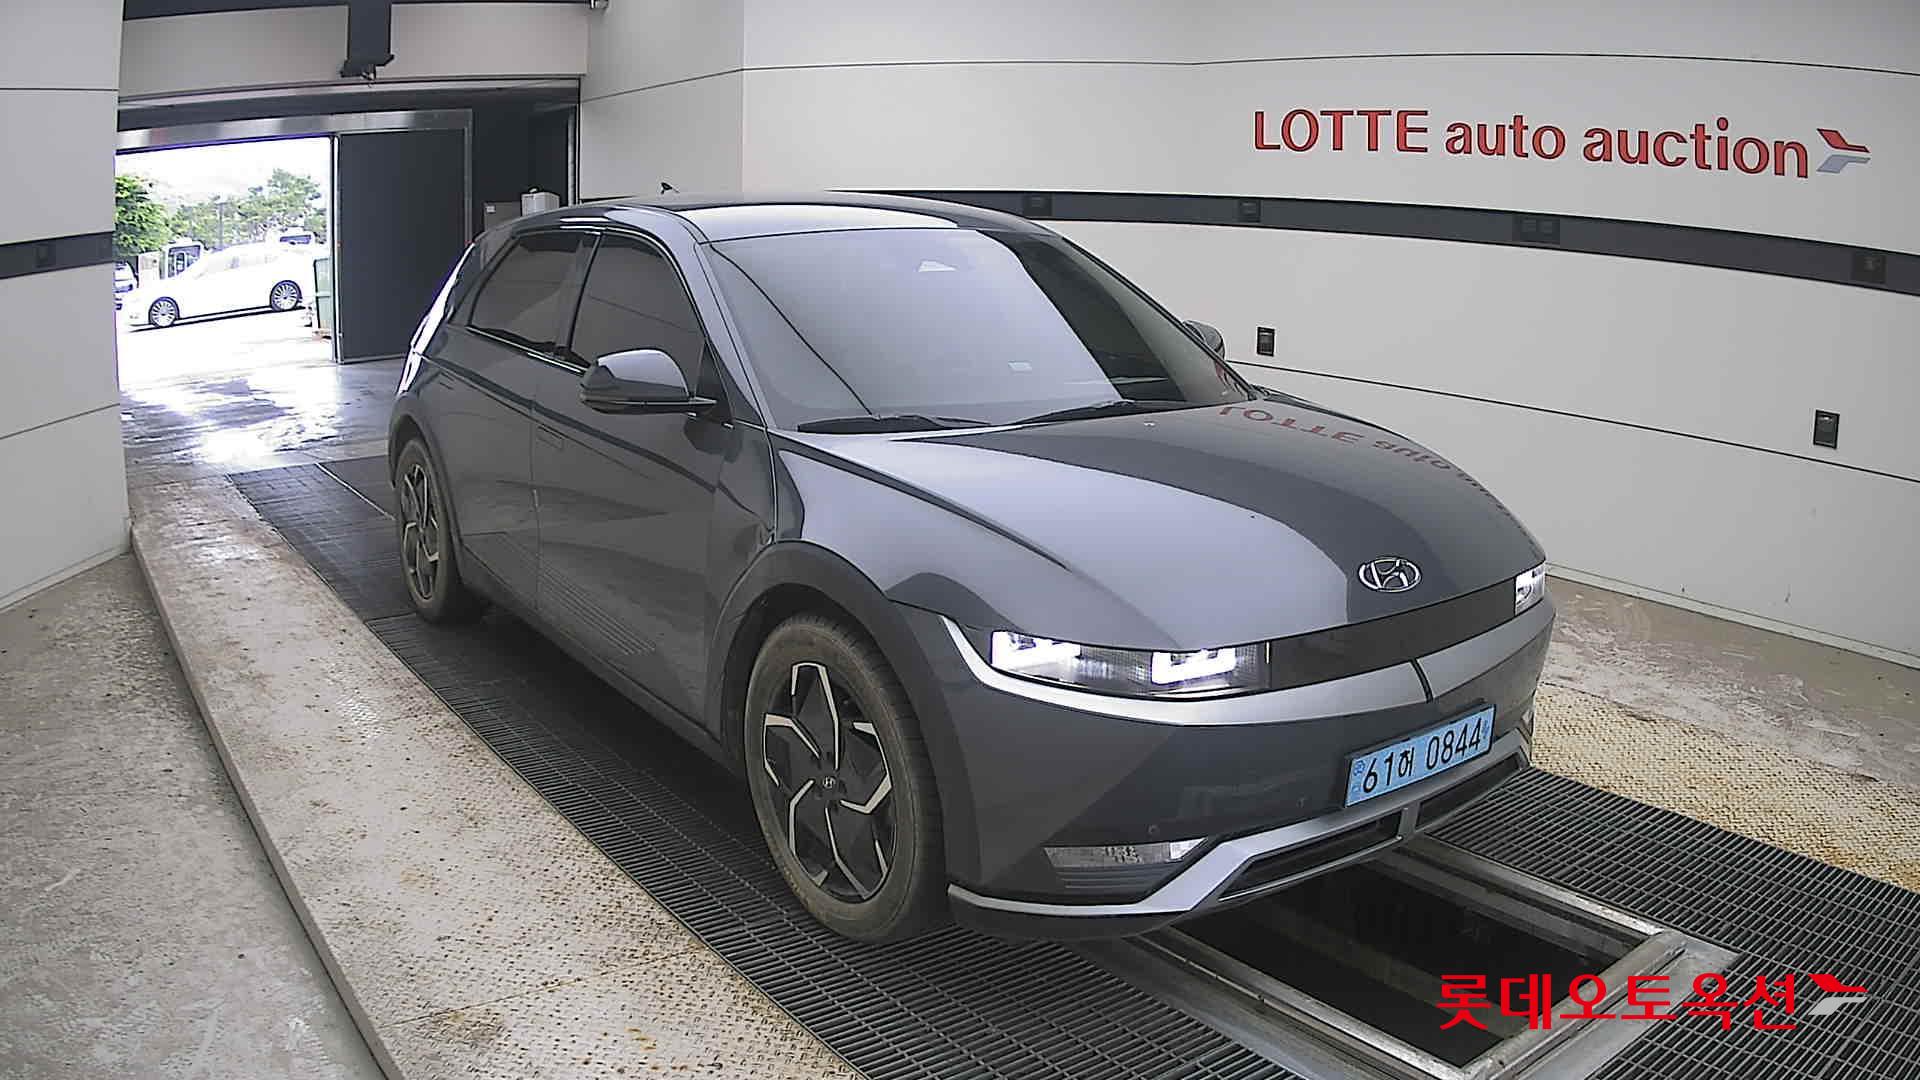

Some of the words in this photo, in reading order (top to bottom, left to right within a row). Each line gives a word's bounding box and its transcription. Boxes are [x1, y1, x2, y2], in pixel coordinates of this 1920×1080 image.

[1254, 110, 1429, 153] LOTTE
[1445, 114, 1567, 160] auto
[1582, 116, 1808, 179] auction
[1363, 747, 1415, 793] 61허
[1426, 718, 1482, 770] 0844
